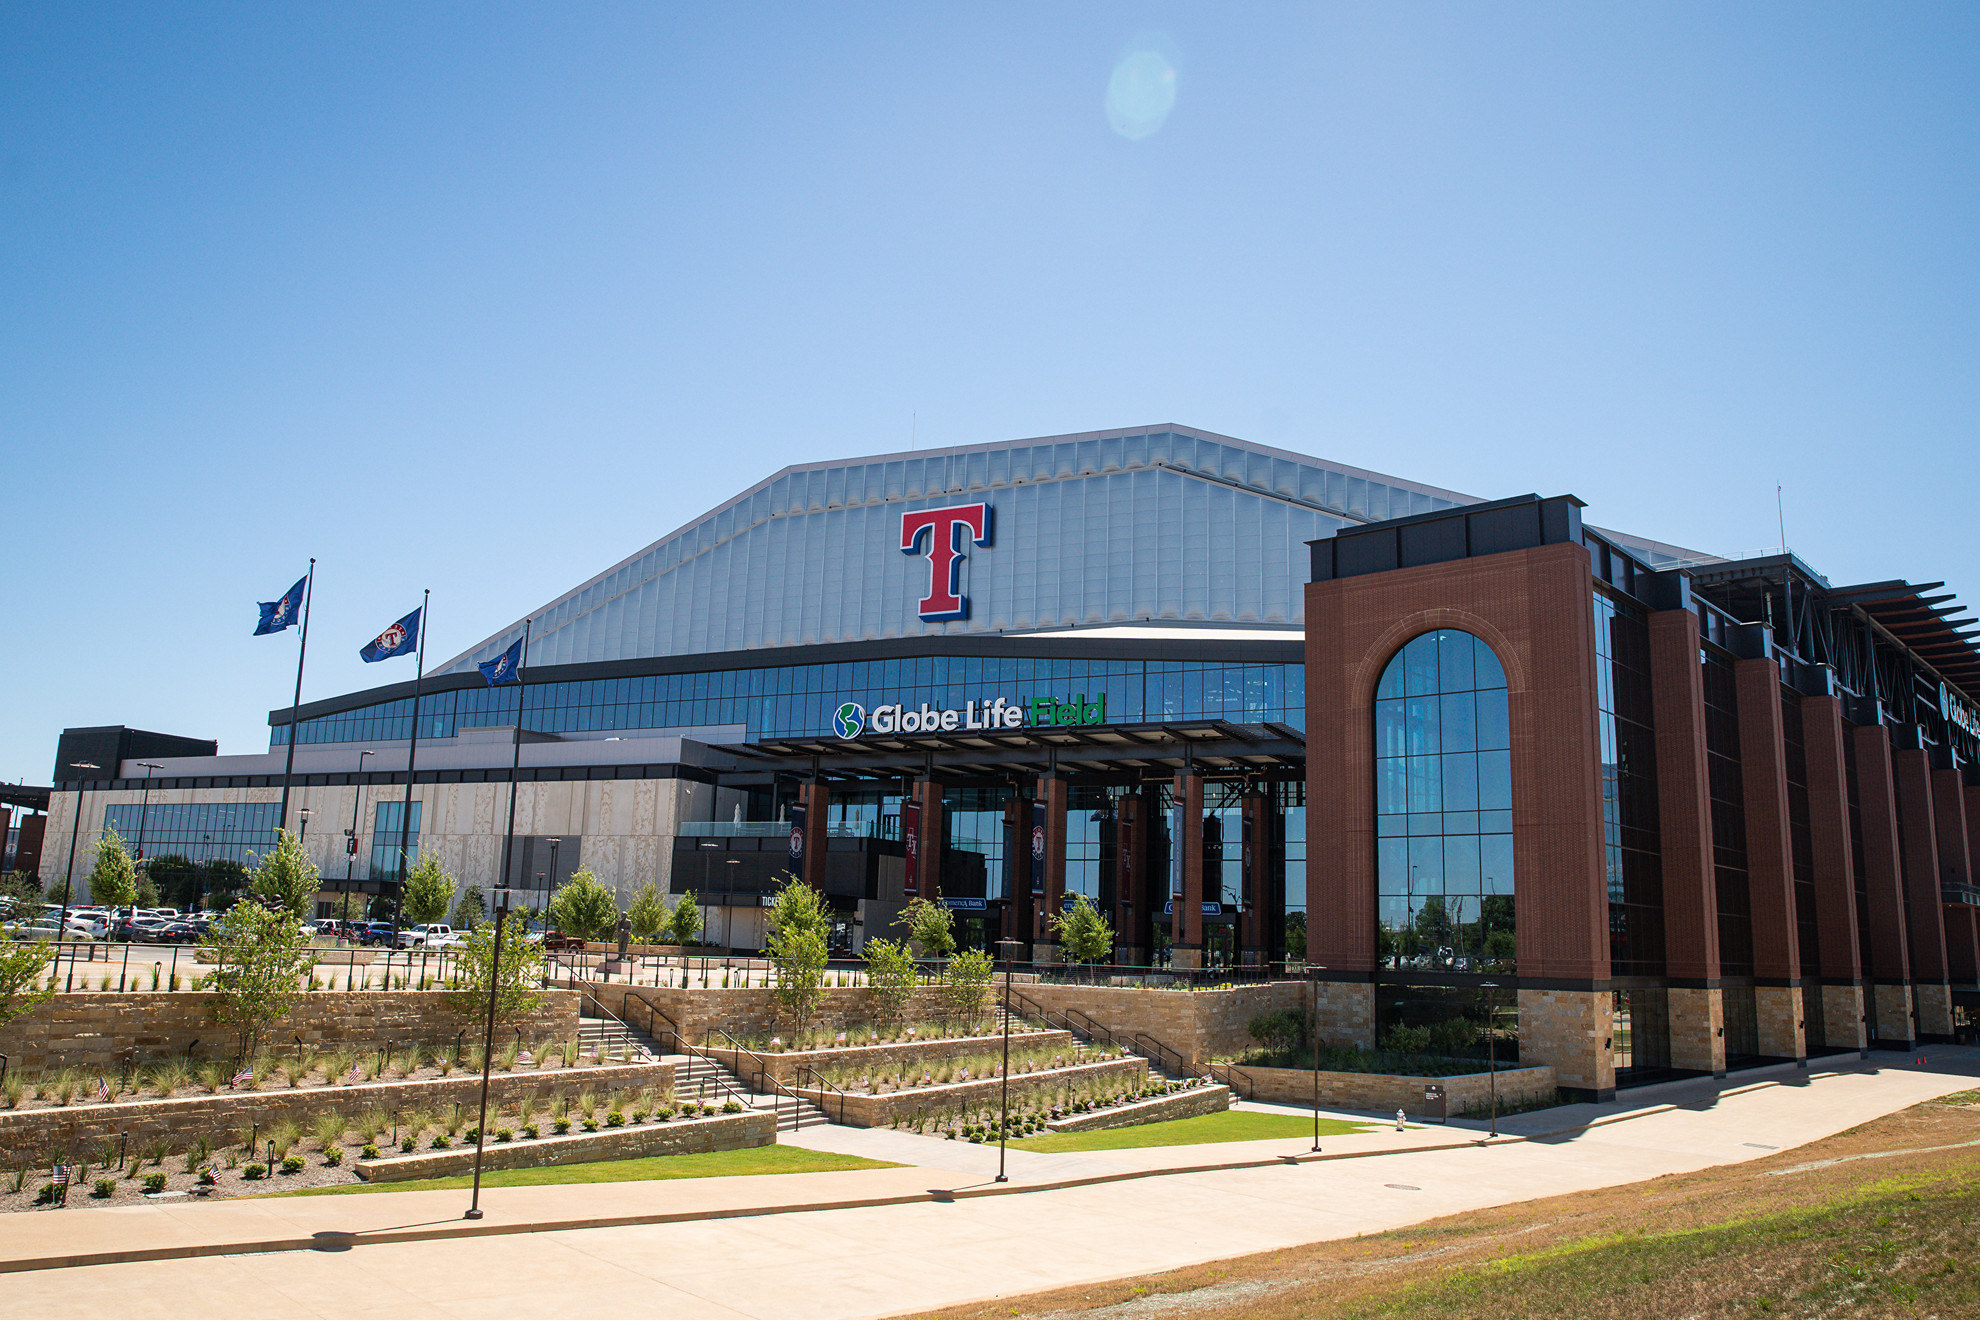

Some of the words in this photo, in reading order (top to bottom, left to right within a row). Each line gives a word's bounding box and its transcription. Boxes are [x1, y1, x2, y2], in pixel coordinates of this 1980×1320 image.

[900, 502, 992, 622] T
[385, 631, 398, 646] T
[872, 694, 960, 733] Globe
[966, 697, 1023, 729] Life
[1031, 692, 1105, 727] Field
[1949, 692, 1970, 732] Globe
